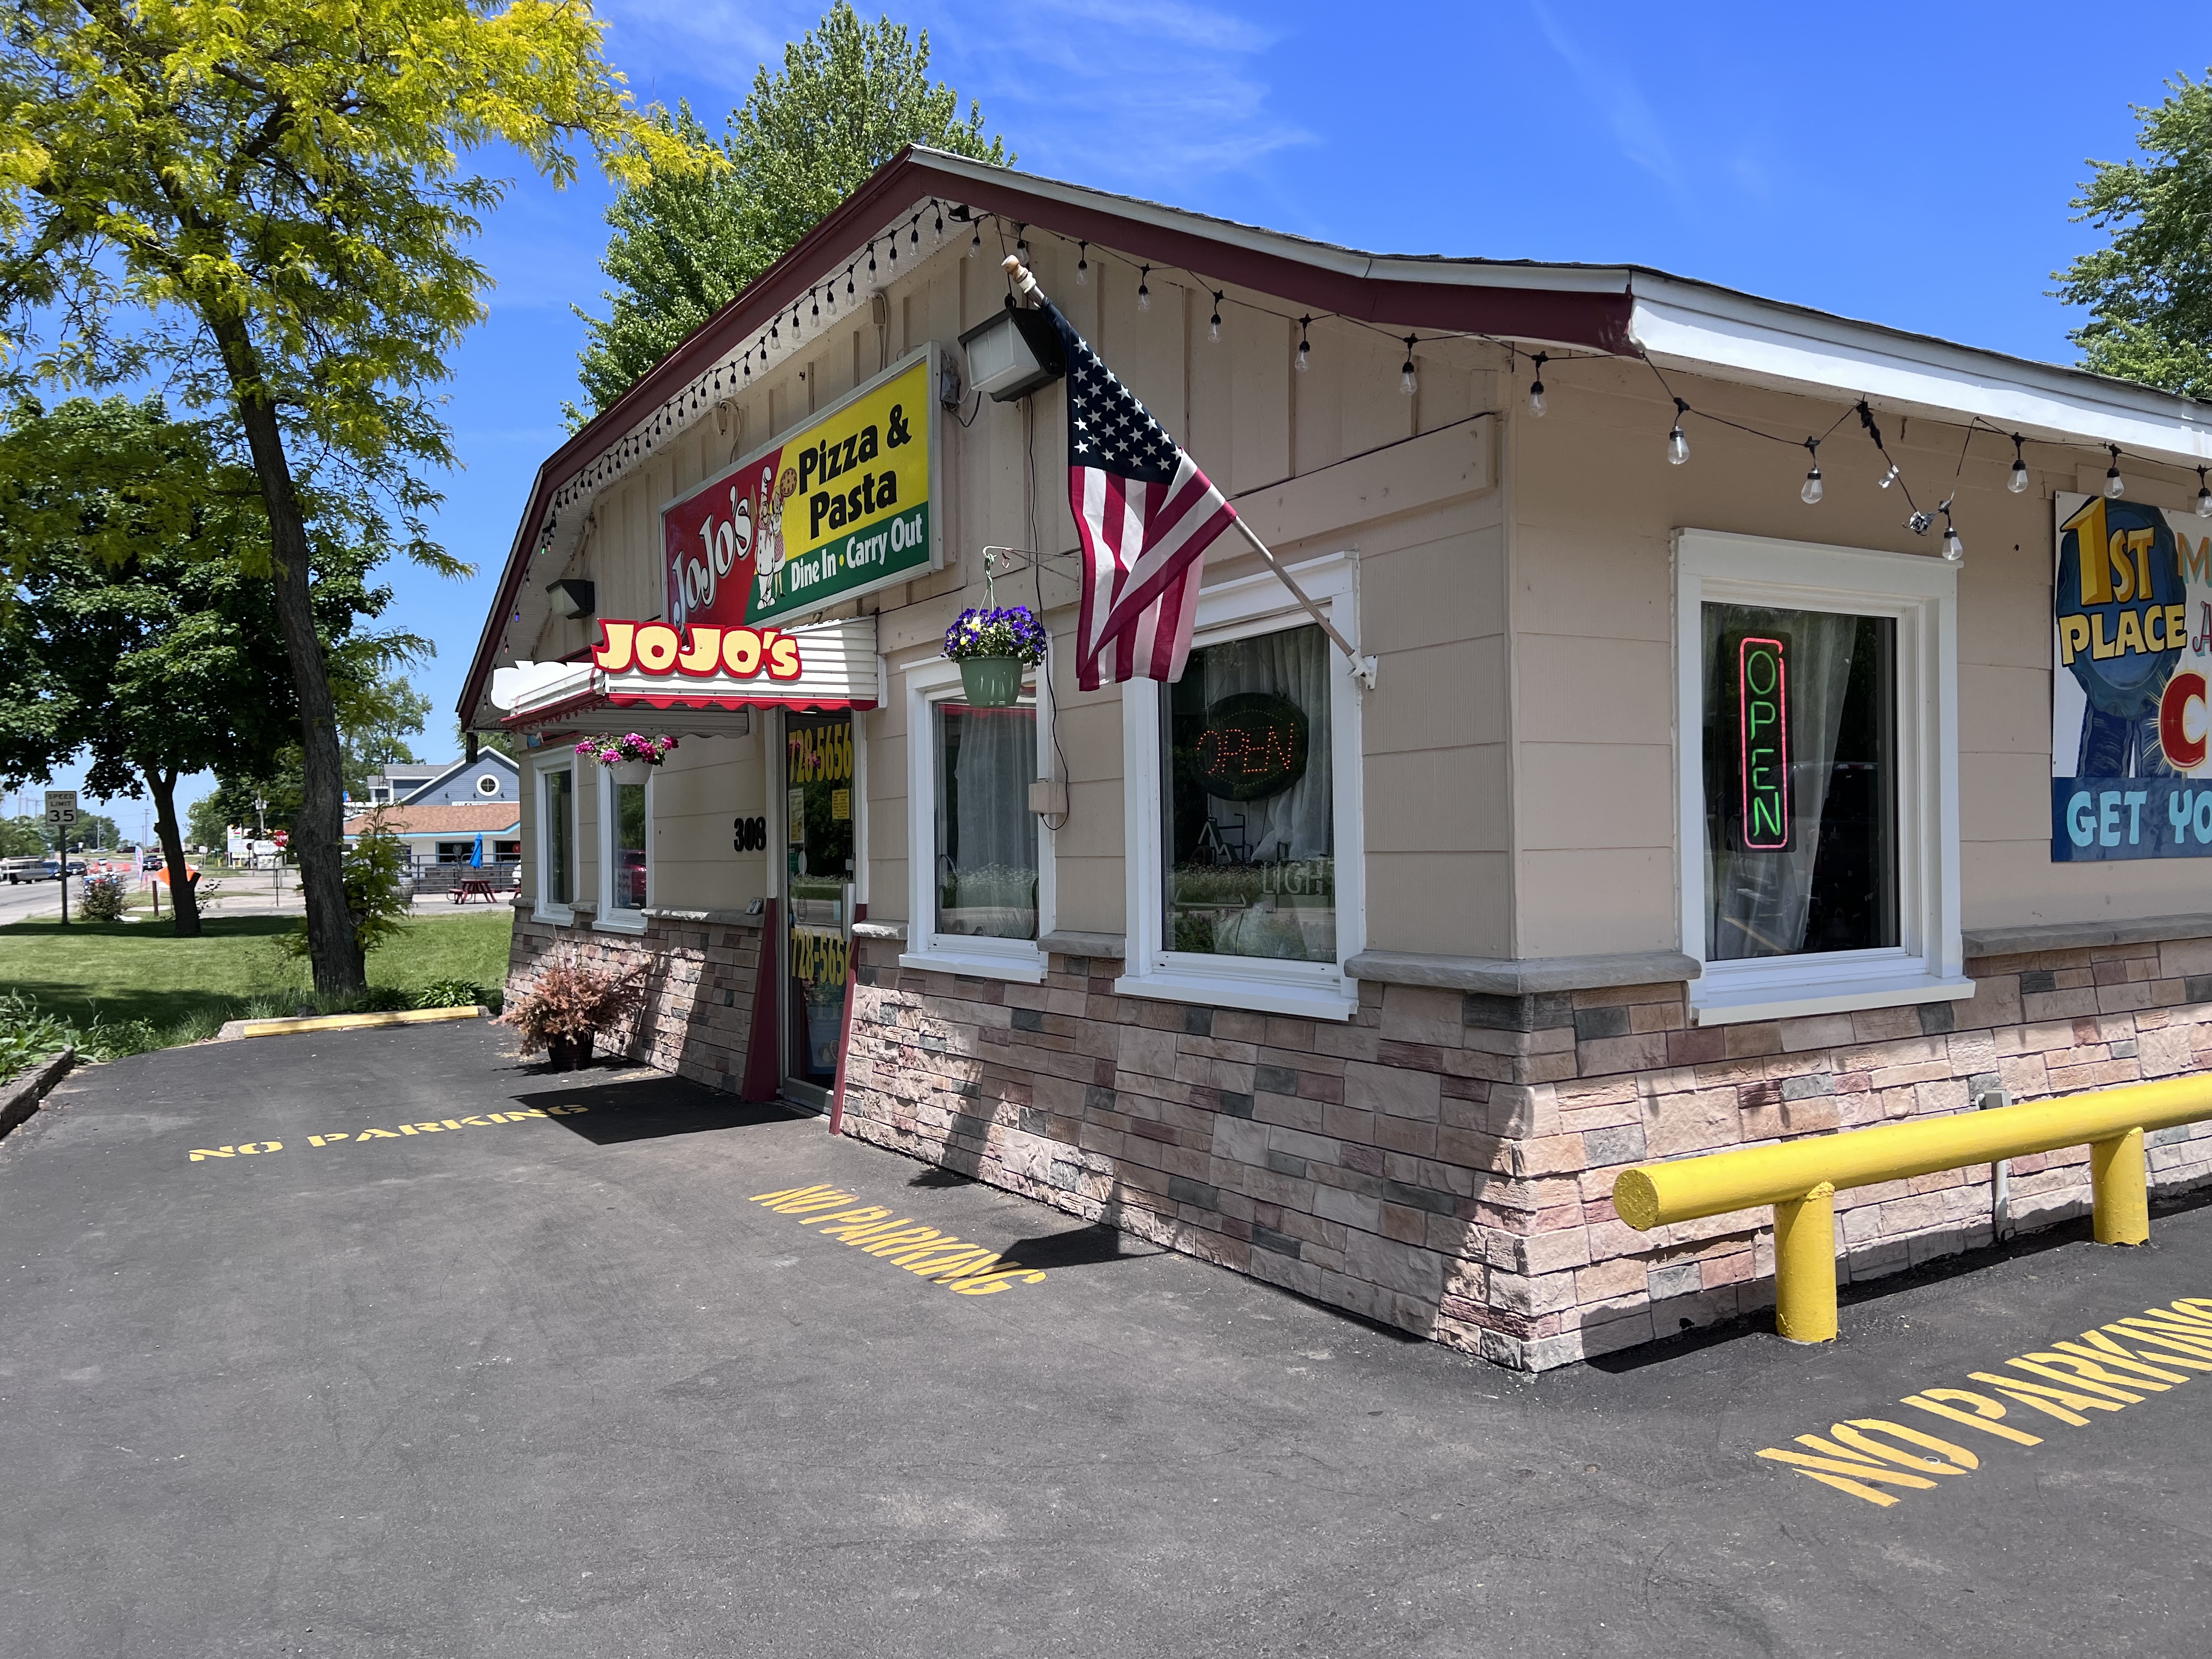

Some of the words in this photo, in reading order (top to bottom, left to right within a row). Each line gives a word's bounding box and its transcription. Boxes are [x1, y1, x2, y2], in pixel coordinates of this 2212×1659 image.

[799, 425, 878, 495] Pizza
[887, 404, 912, 449] &
[810, 470, 898, 540] Pasta
[791, 557, 820, 592] Dine
[821, 548, 837, 580] In
[846, 531, 888, 569] Carry
[890, 513, 923, 552] Out
[2059, 496, 2155, 606] 1ST
[2058, 602, 2187, 667] PLACE
[788, 722, 853, 783] 728-5656
[1197, 722, 1295, 774] OPEN
[1747, 650, 1781, 837] OPEN
[49, 809, 74, 822] 35
[733, 816, 767, 852] 308
[2066, 790, 2148, 847] GET
[188, 1141, 283, 1161] NO
[307, 1104, 590, 1147] PARKING
[749, 1183, 860, 1214] NO
[798, 1205, 1047, 1295] PARKING
[1754, 1418, 1979, 1507] NO
